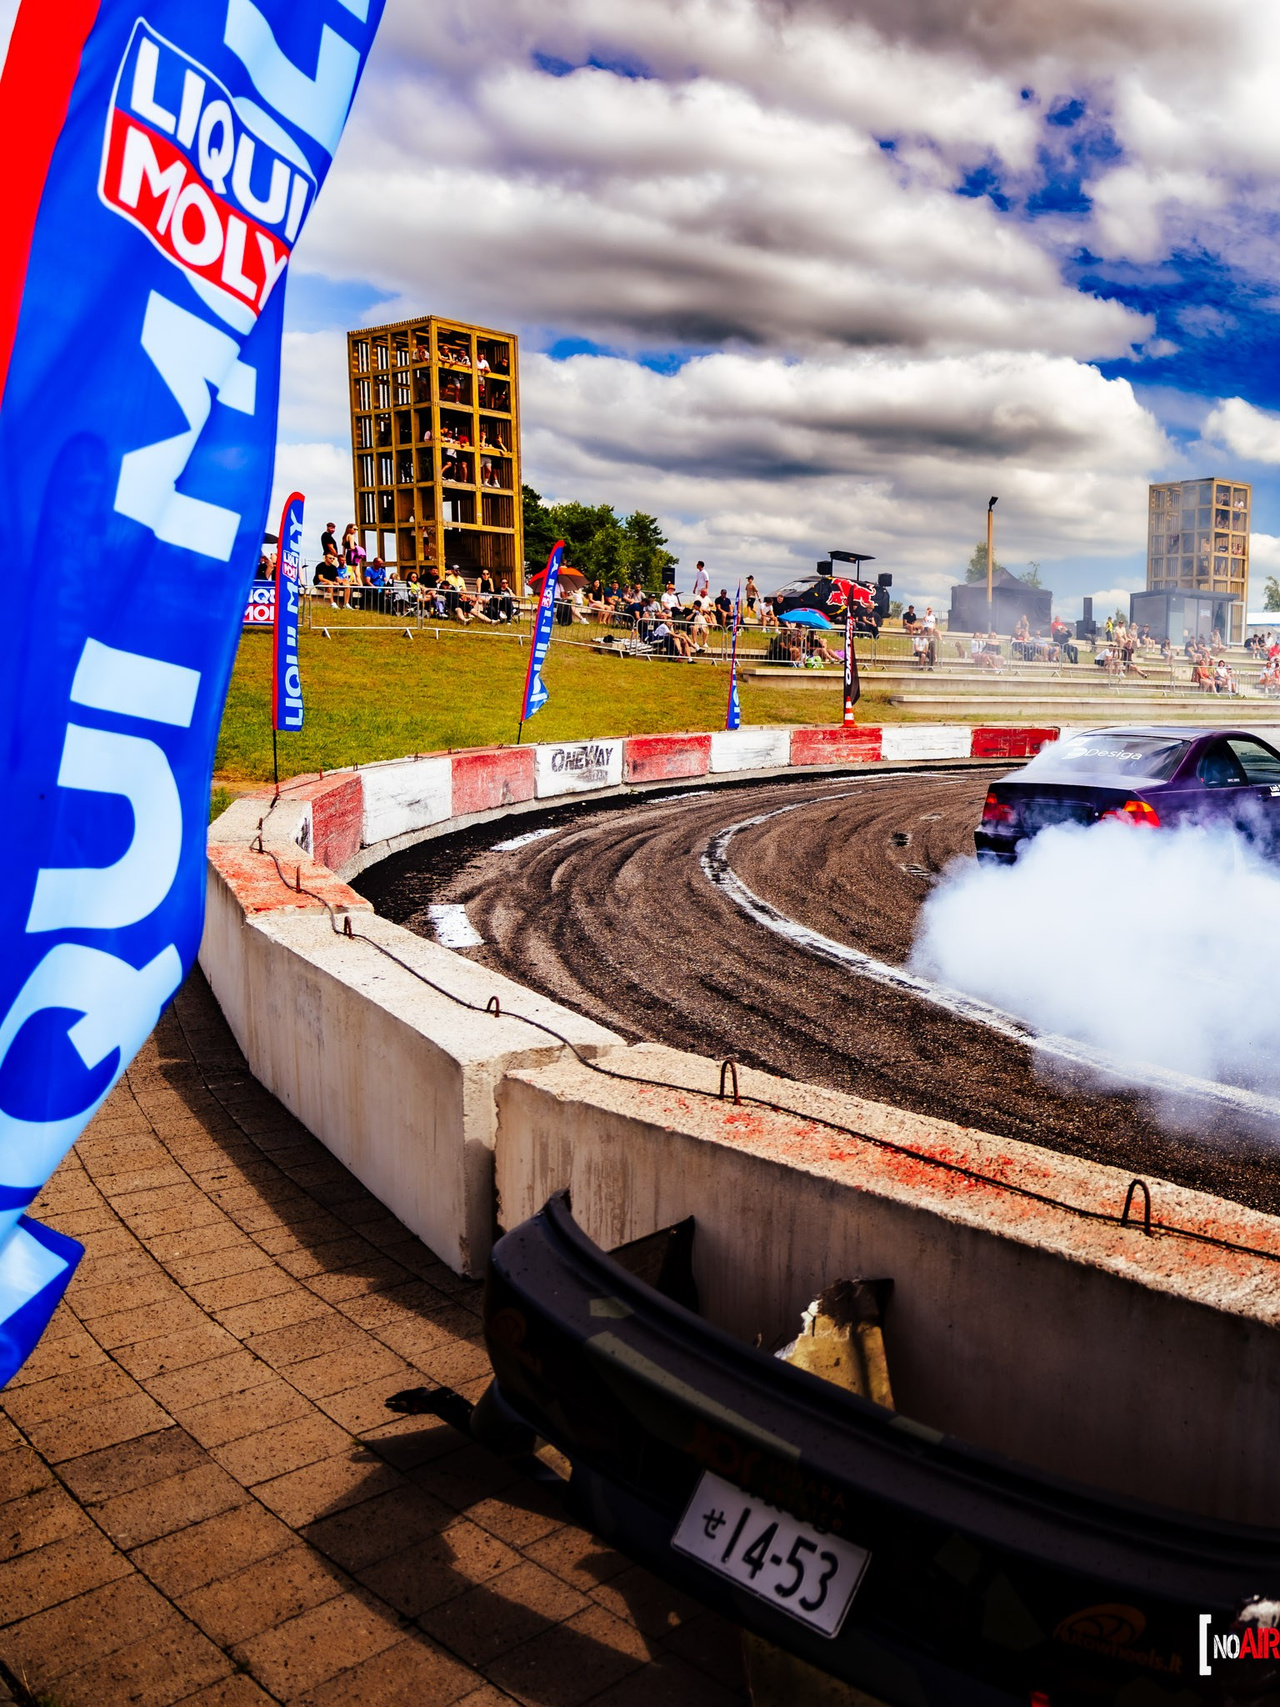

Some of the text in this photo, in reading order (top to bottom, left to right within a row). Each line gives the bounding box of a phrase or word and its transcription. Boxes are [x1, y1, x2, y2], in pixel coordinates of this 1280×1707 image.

[131, 37, 308, 243] LIQUI
[118, 125, 288, 312] MOLY
[1084, 748, 1143, 761] Desiga
[703, 1508, 726, 1540] せ
[721, 1507, 839, 1612] 14-53
